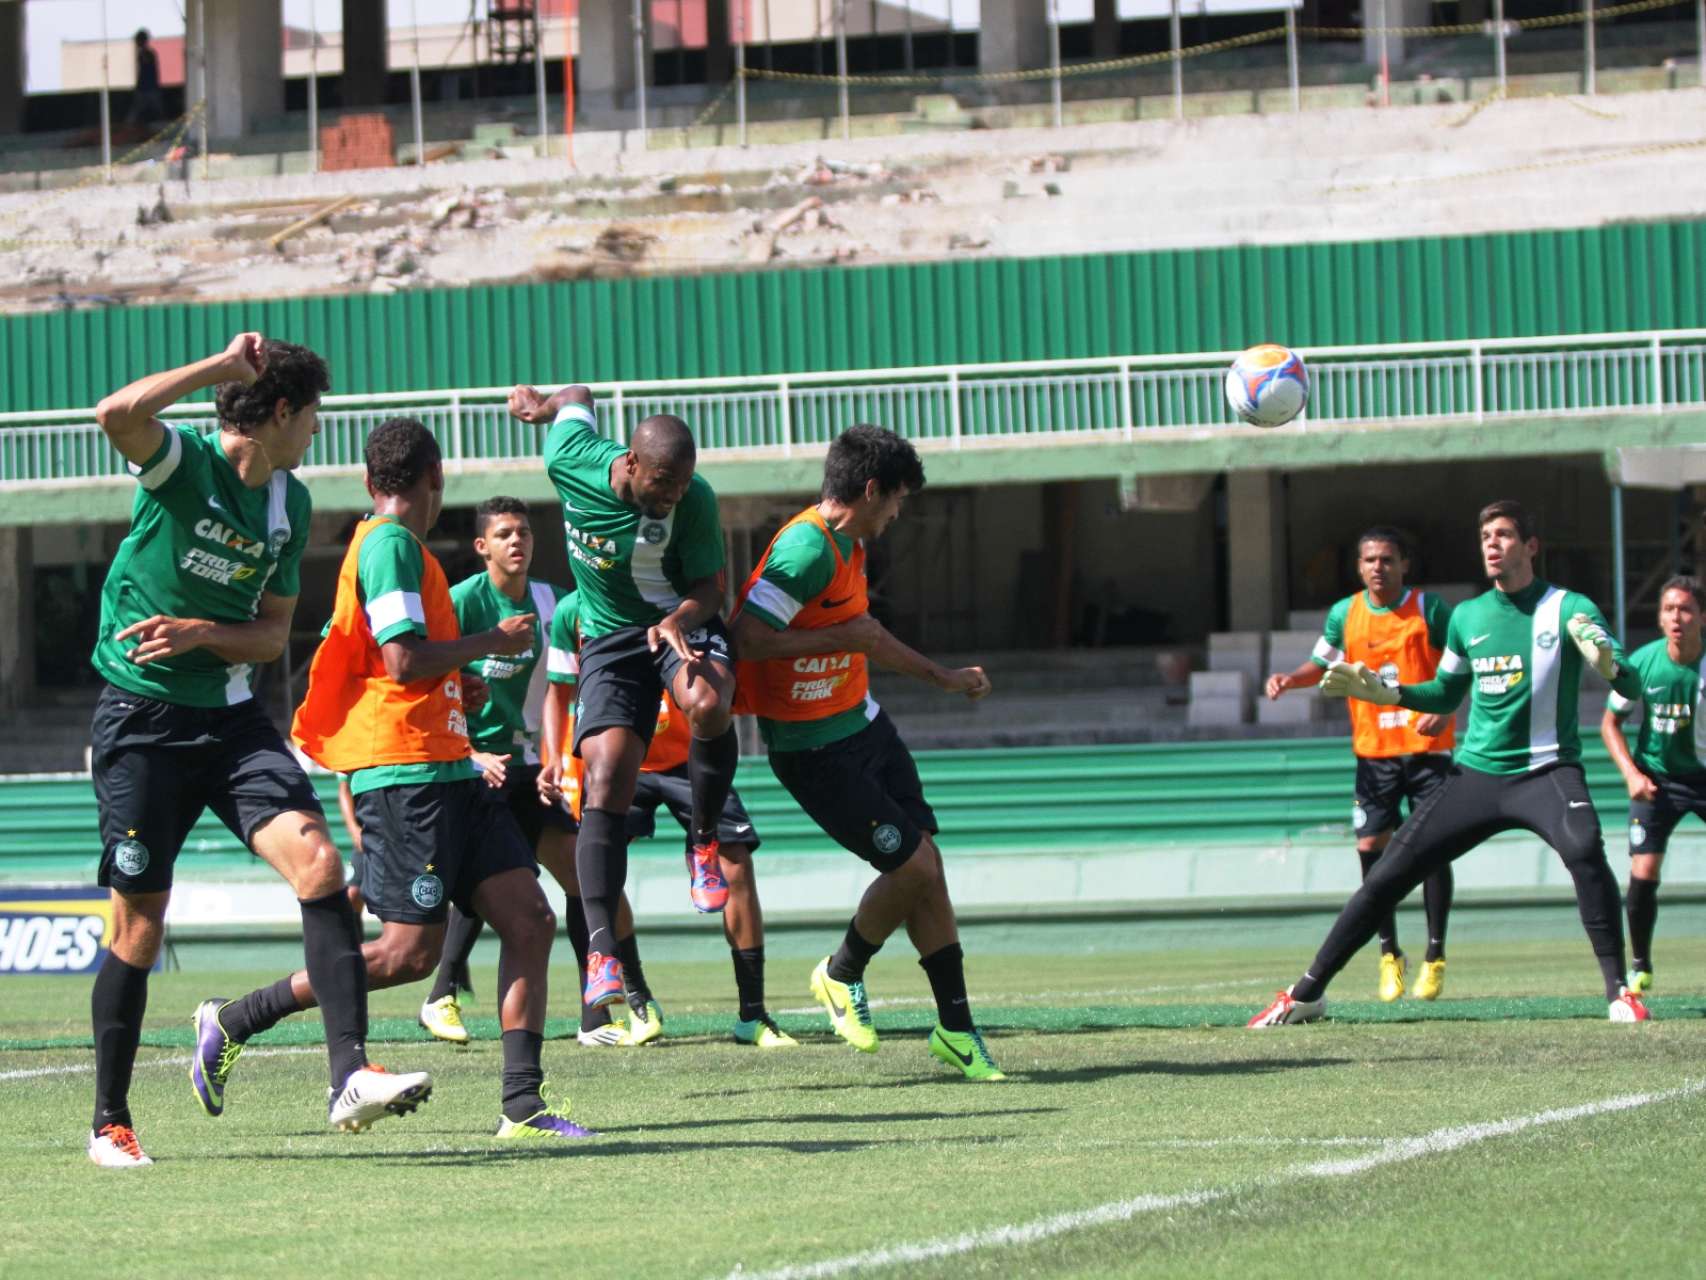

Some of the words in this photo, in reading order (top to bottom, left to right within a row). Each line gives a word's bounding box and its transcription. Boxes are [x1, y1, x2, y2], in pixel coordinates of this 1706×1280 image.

[194, 518, 265, 558] CAIXA
[187, 547, 230, 571] PRO
[180, 557, 232, 586] TORK
[793, 654, 851, 673] CAIXA
[1472, 655, 1522, 672] CAIXA
[791, 686, 832, 700] TORK
[0, 916, 104, 970] HOES
